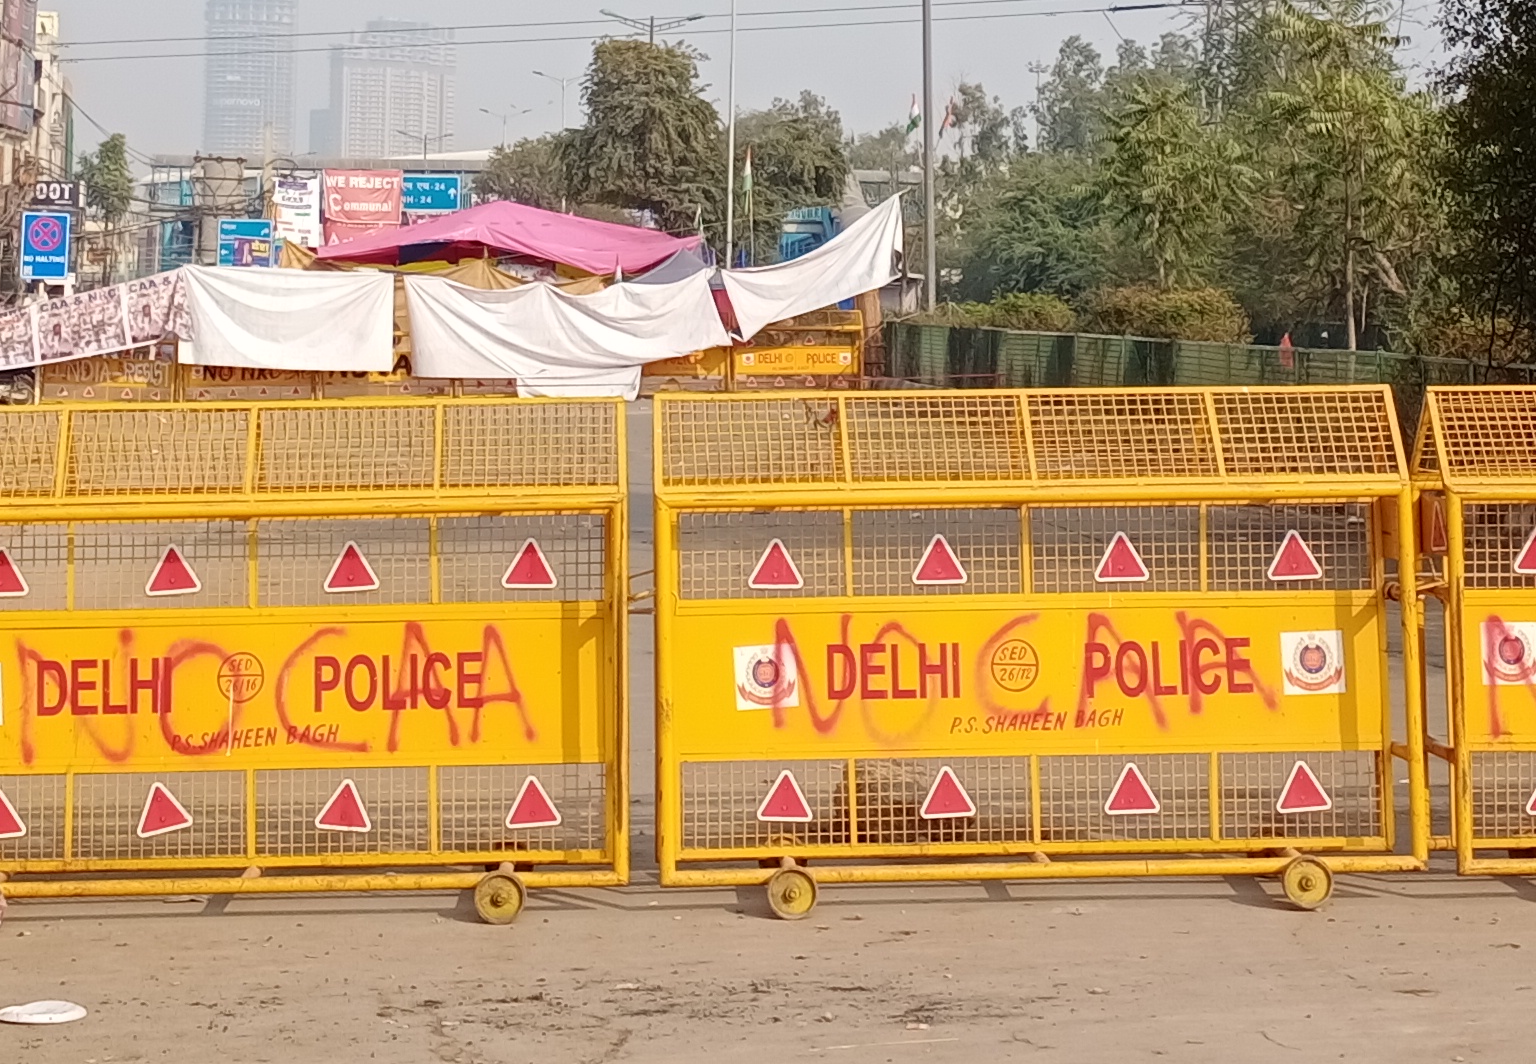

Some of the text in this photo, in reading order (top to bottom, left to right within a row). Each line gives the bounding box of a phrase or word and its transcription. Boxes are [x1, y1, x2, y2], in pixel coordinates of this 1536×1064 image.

[326, 176, 400, 189] WE REJECT
[329, 194, 392, 212] Communal
[24, 255, 34, 263] NO
[129, 279, 158, 293] CAA
[162, 276, 172, 286] &
[40, 287, 117, 312] CAA & NRC
[758, 353, 836, 364] DELHI POLICE
[123, 361, 172, 385] RESIST
[1000, 646, 1027, 661] SED
[228, 657, 255, 674] SED
[826, 637, 1252, 700] DELHI POLICE
[36, 651, 484, 718] DELHI POLICE
[773, 613, 938, 746] NO
[15, 621, 538, 767] NO CAA
[1074, 709, 1124, 728] BAGH
[286, 723, 339, 746] BAGH
